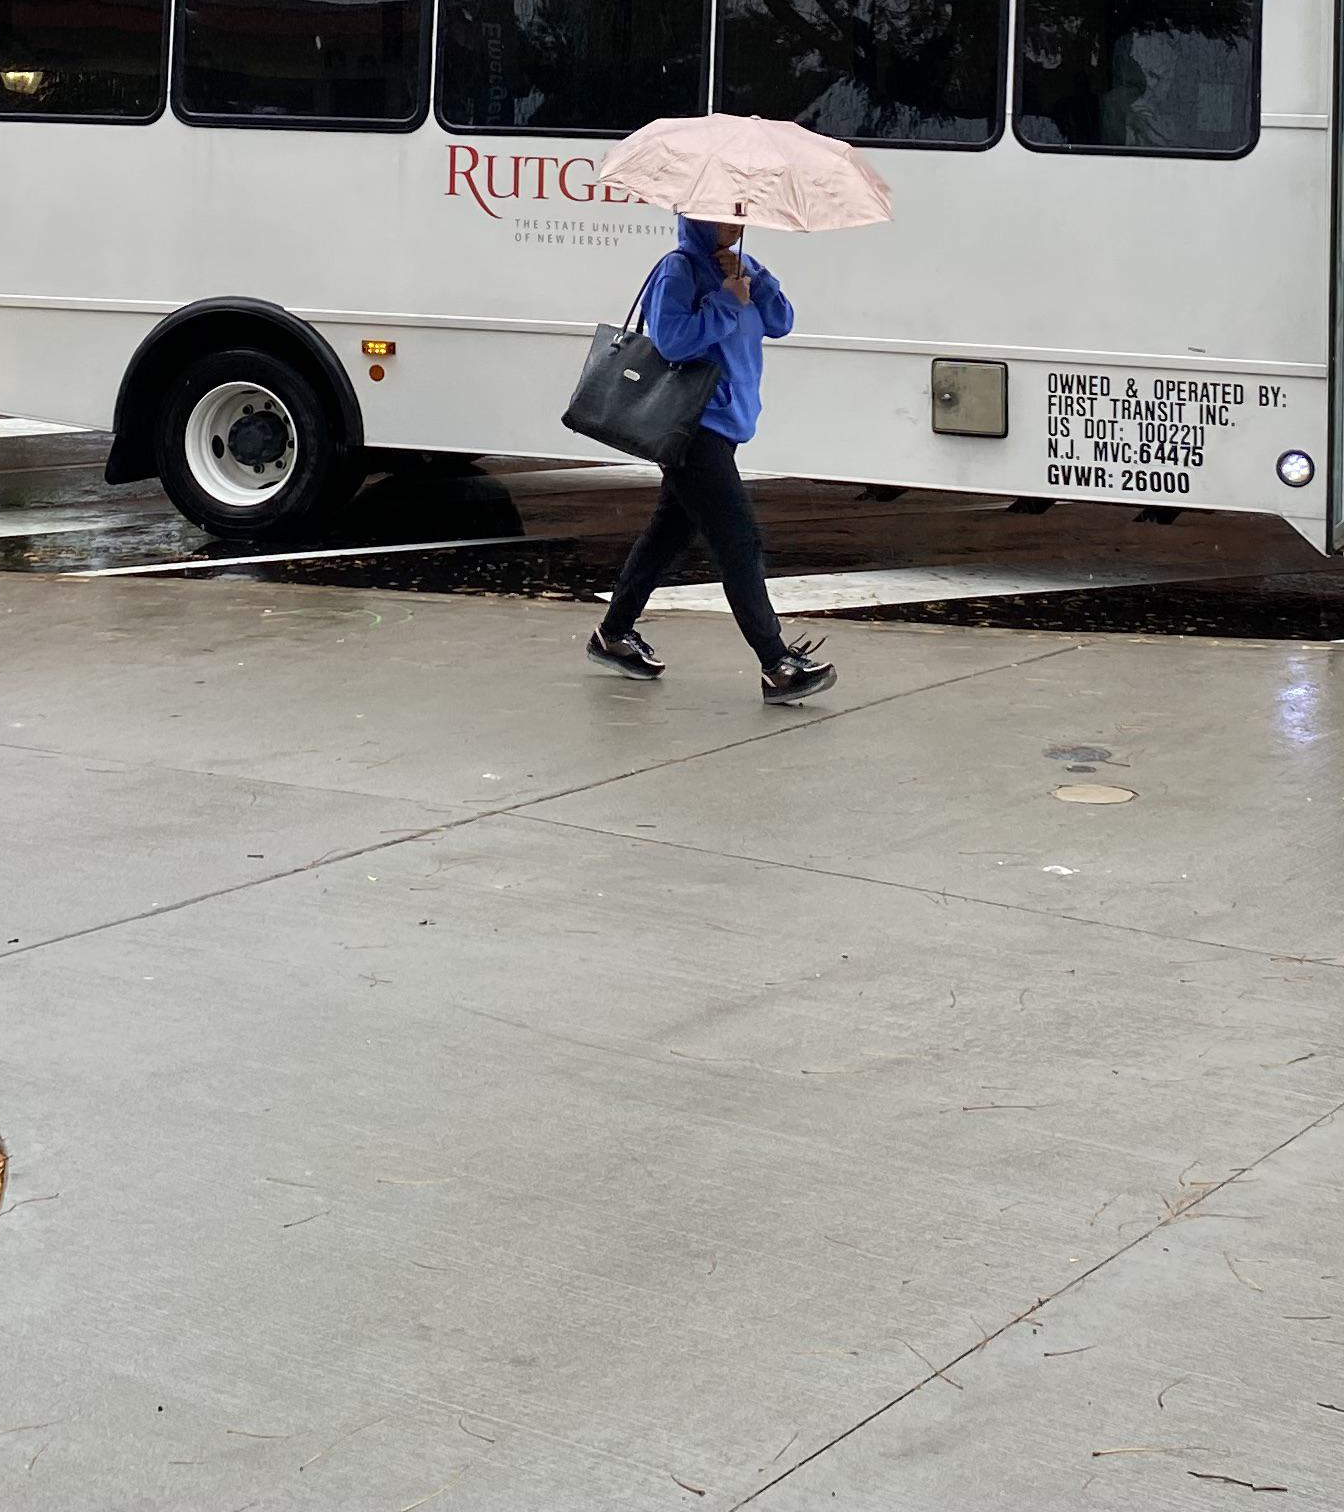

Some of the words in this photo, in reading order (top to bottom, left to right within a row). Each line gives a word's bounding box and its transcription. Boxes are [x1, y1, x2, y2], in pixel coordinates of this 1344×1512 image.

[445, 144, 649, 219] RUTG
[514, 232, 531, 243] OF
[537, 233, 565, 245] NEW
[572, 235, 620, 247] JERSEY
[515, 218, 539, 230] THE
[545, 220, 585, 232] STATE
[592, 222, 675, 236] UNIVERSITY
[1047, 372, 1111, 397] OWNED
[1126, 377, 1139, 399] &
[1153, 378, 1244, 405] OPERATED
[1258, 385, 1288, 408] BY:
[1047, 395, 1098, 418] FIRST
[1109, 398, 1187, 424] TRANSIT
[1199, 404, 1237, 428] INC.
[1047, 416, 1070, 438] US
[1084, 419, 1124, 442] DOT:
[1137, 421, 1205, 447] 1002211
[1047, 437, 1081, 461] N.J.
[1047, 464, 1114, 489] GVWR:
[1121, 470, 1190, 494] 26000
